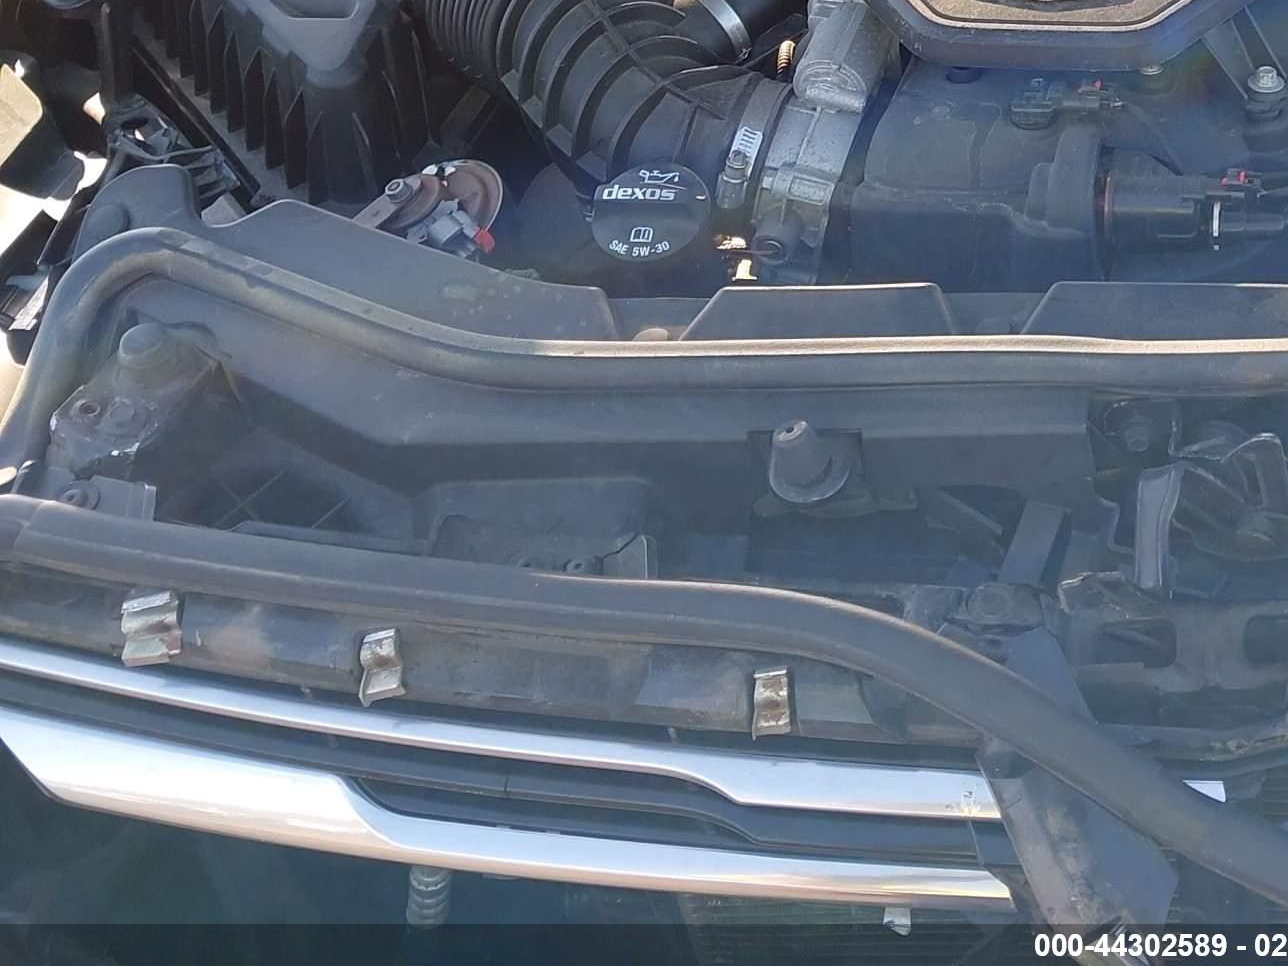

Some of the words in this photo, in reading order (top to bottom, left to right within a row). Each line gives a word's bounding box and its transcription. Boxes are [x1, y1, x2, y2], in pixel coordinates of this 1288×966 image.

[602, 184, 678, 201] dexos
[609, 239, 630, 255] SAE
[632, 240, 670, 257] 5W-30
